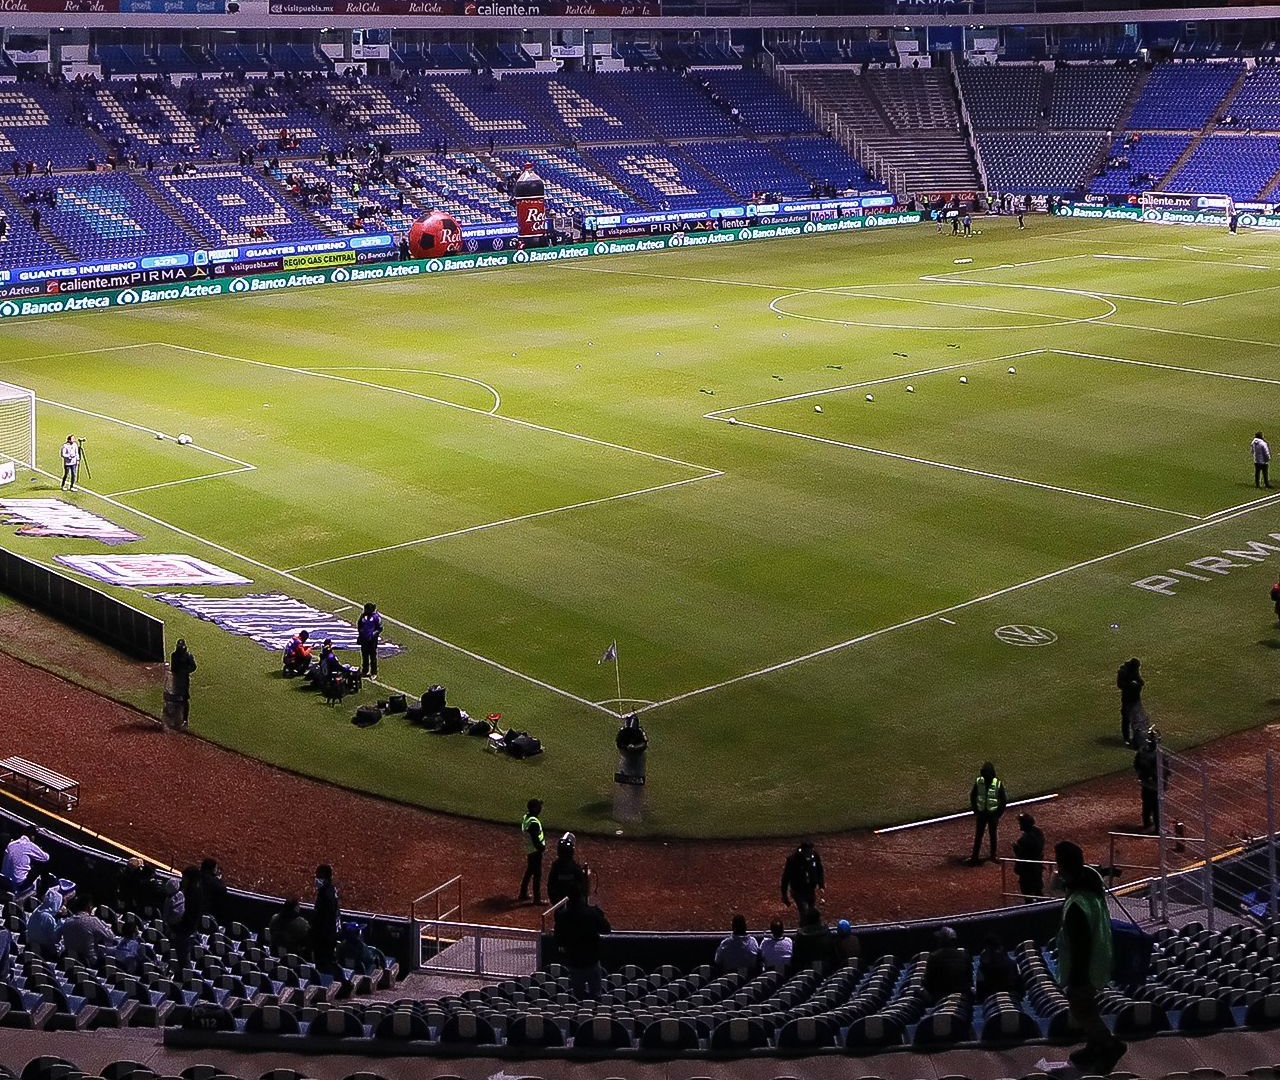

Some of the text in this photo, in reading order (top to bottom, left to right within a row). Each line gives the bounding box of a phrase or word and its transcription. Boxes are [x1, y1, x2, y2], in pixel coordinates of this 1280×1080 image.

[283, 4, 333, 14] visitpuebla.mx
[812, 208, 861, 221] Mobil obil
[878, 214, 920, 226] Banco Azteca
[1073, 209, 1138, 220] Banco Azteca
[1163, 213, 1193, 222] Banco
[752, 227, 800, 238] Banco Azteca
[817, 220, 861, 232] Banco Azteca
[684, 232, 734, 246] Banco Azteca
[246, 242, 346, 258] GUANTES INVIERNO
[610, 240, 665, 253] Banco Azteca
[284, 252, 355, 266] REGIO GAS CENTRAL
[531, 247, 588, 261] Banco Azteca
[444, 256, 507, 270] Banco Azteca
[19, 262, 136, 280] GUANTES INVIERNO
[131, 268, 186, 283] PIRMA
[351, 263, 419, 281] Banco Azteca
[60, 276, 129, 292] caliente.mx
[252, 274, 325, 290] Banco Azteca
[9, 286, 40, 296] Azteca
[141, 283, 221, 302] Banco Azteca
[21, 297, 109, 315] Banco Azteca
